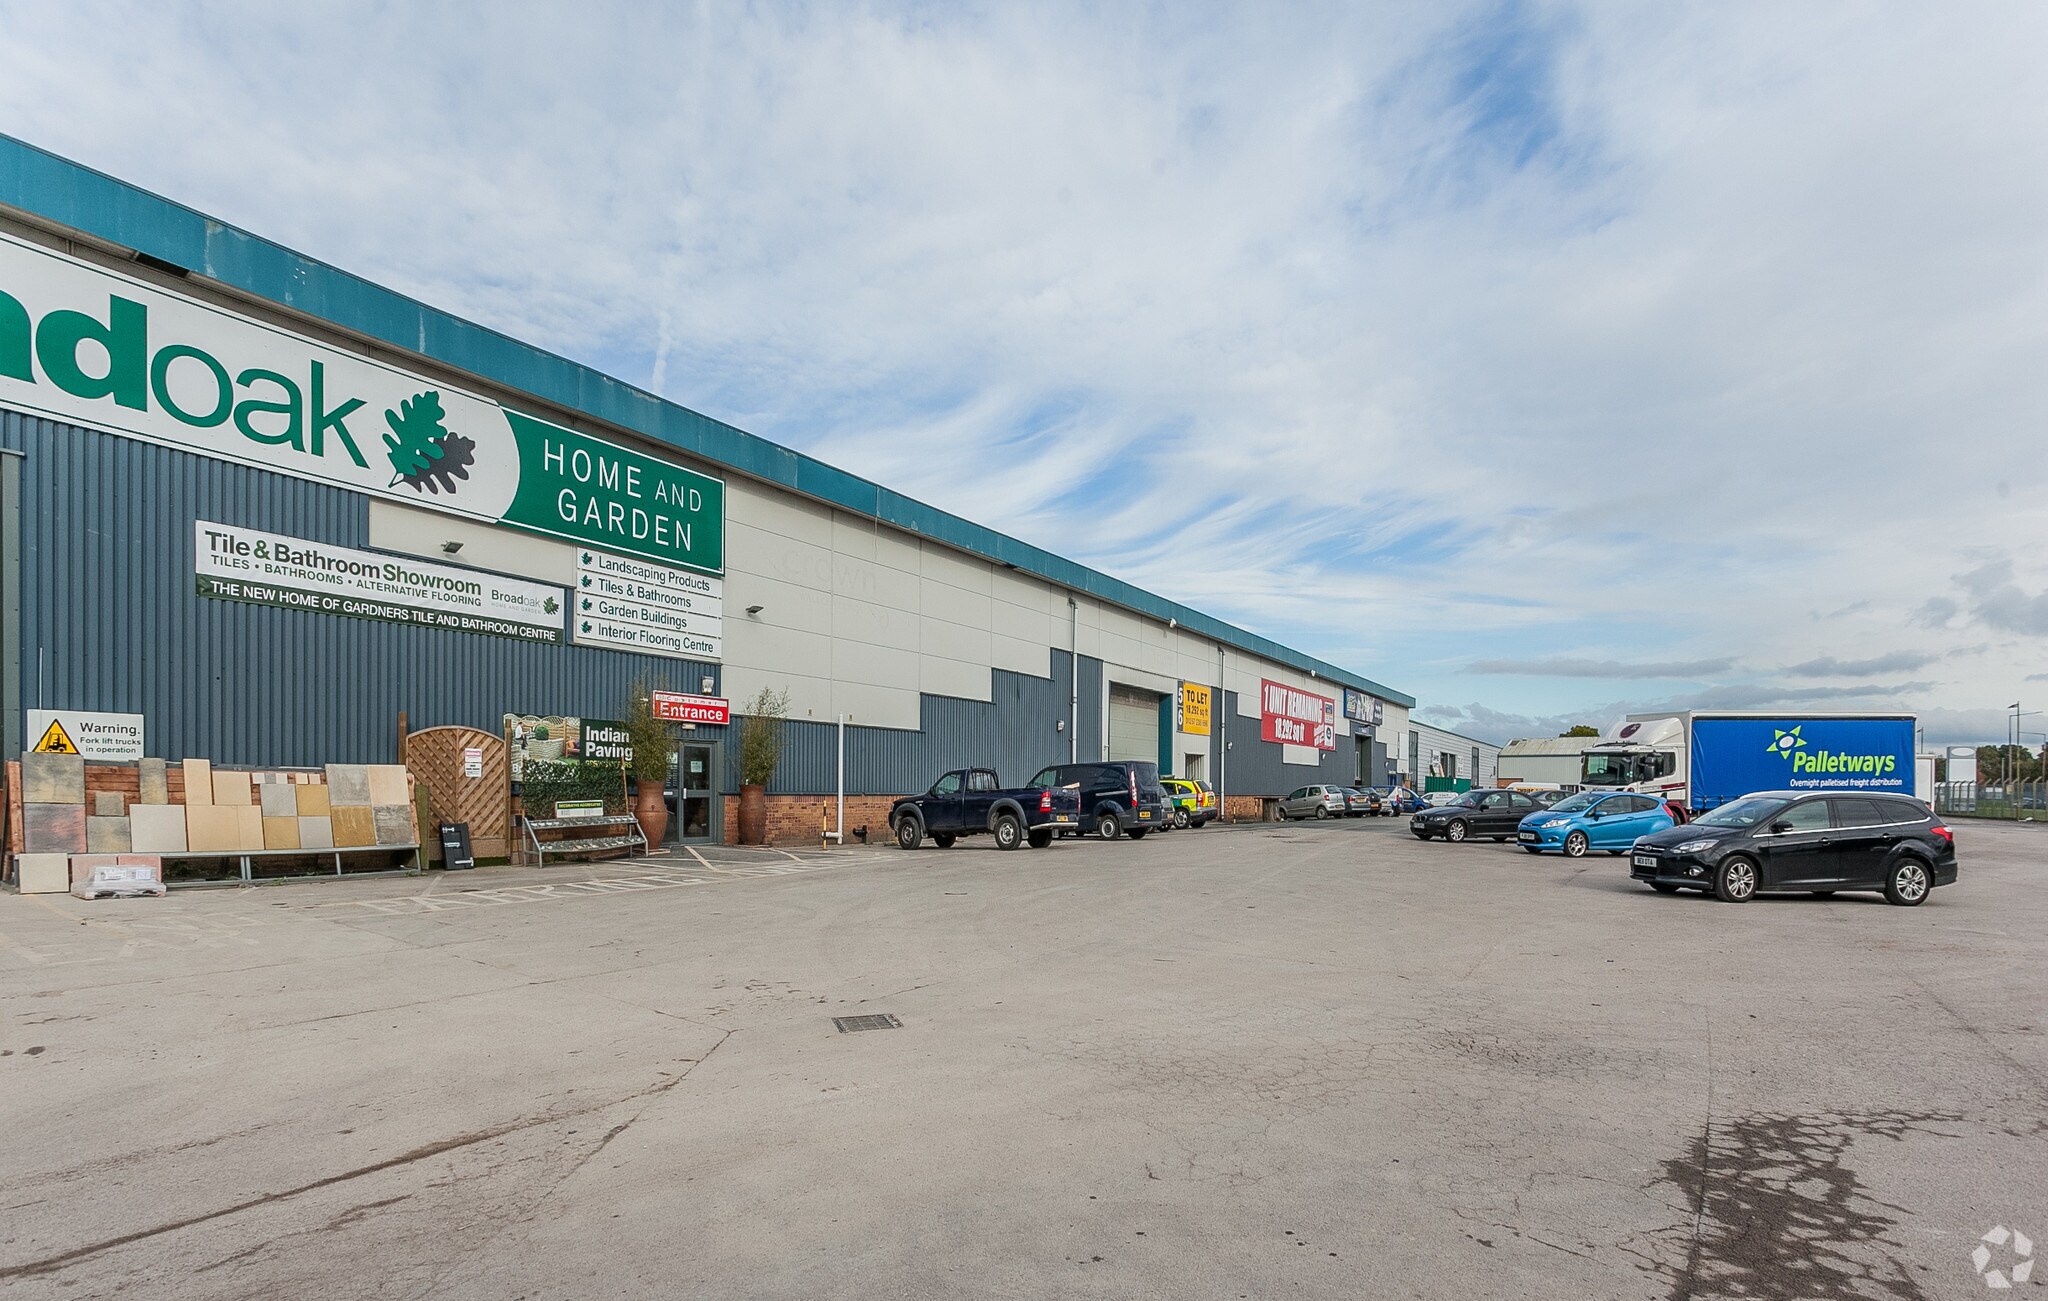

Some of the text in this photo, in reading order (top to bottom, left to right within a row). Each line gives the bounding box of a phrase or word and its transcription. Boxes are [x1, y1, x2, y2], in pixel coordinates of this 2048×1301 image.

[544, 438, 702, 512] HOME AND
[557, 488, 691, 551] GARDEN
[205, 530, 482, 596] Tile & Bathroom Showroom
[598, 555, 710, 592] Landscaping Products
[211, 554, 482, 607] TILES BATHROOMS ALTERNATIVE FLOORING
[491, 589, 541, 608] Broadoak
[598, 577, 692, 608] Tiles & Bathrooms
[210, 580, 556, 641] THE NEW HOME OF GARDNERS TILE AND BATHROOM CENTRE
[598, 600, 687, 630] Garden Buildings
[598, 622, 714, 653] Interior Flooring Centre
[1178, 687, 1183, 704] 5
[1186, 689, 1208, 706] TO LET
[1269, 685, 1287, 716] UNIT
[1287, 690, 1323, 724] REMAINING
[660, 702, 723, 721] Entrance
[1178, 708, 1183, 726] 6
[80, 722, 141, 737] Warning.
[80, 736, 141, 746] Fork lift trucks
[585, 725, 630, 743] Indian
[86, 745, 136, 754] in operation
[585, 741, 633, 761] Paving
[1793, 750, 1895, 777] Palletways
[1790, 777, 1903, 789] Overnight palletised freight distribution
